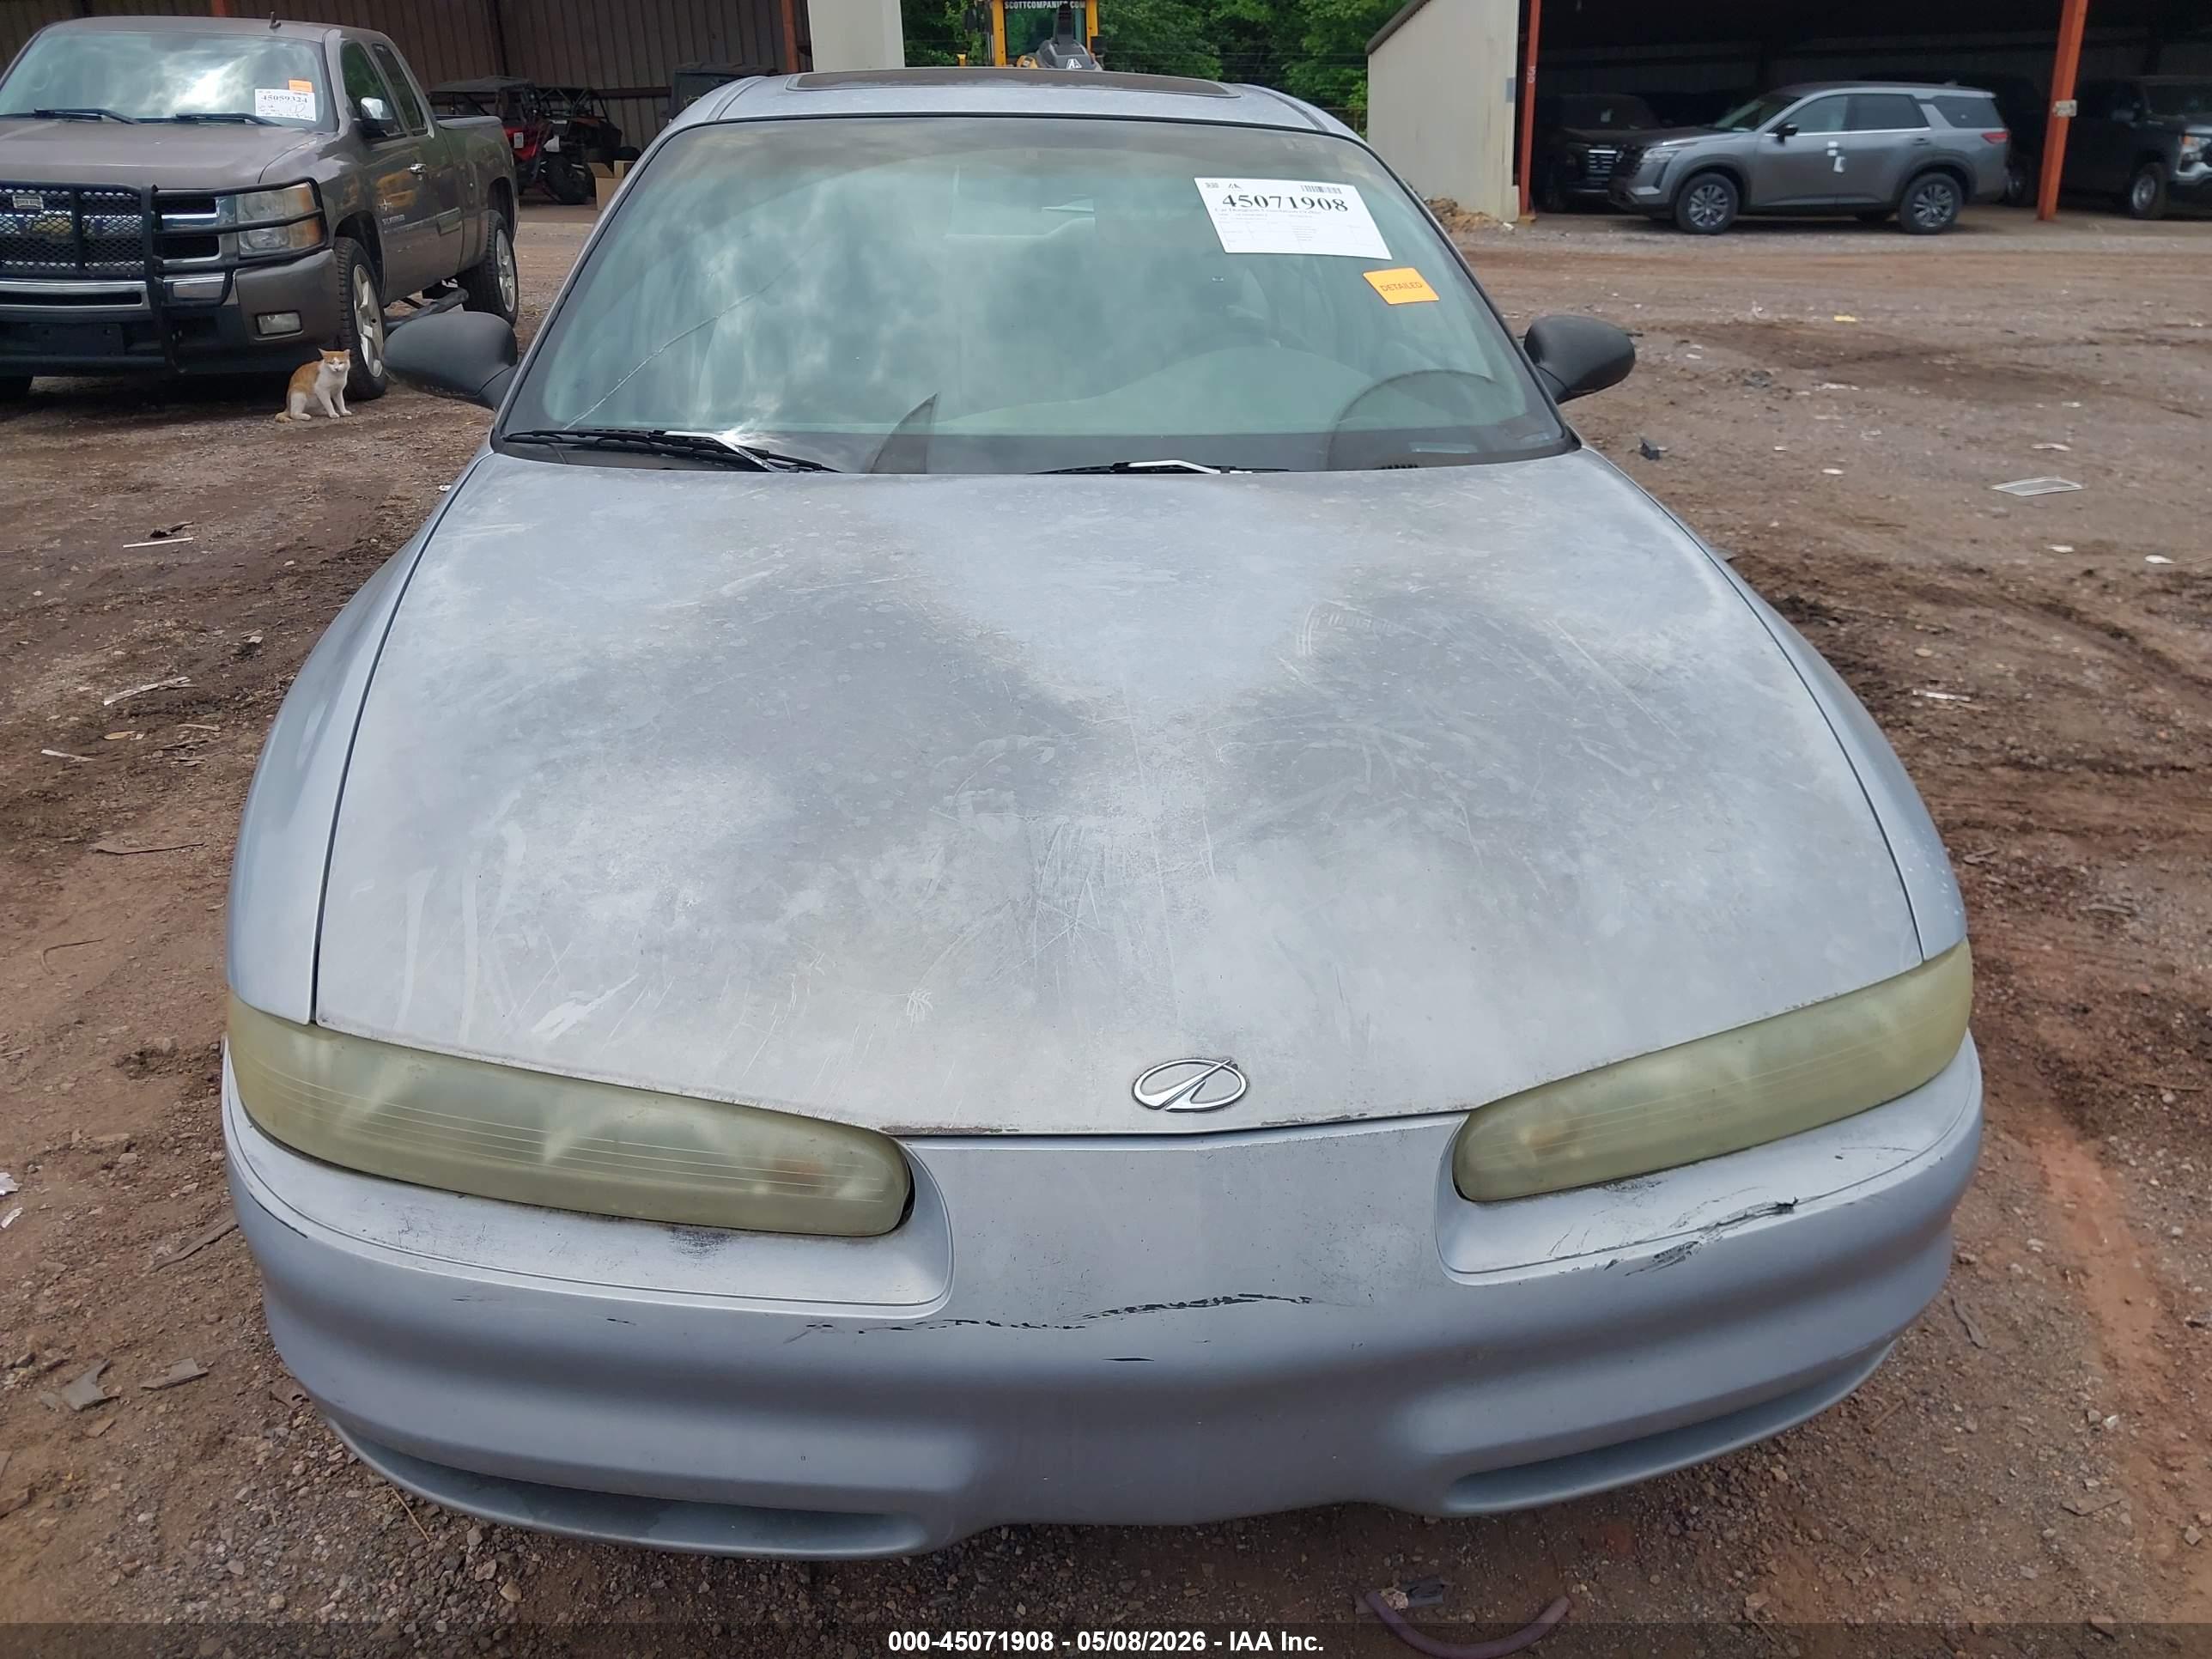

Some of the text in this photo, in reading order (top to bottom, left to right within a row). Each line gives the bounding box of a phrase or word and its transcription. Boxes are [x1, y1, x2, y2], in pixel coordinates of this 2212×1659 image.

[260, 94, 308, 103] 45059324
[1222, 194, 1349, 212] 45071908
[1379, 282, 1423, 292] DETAILED
